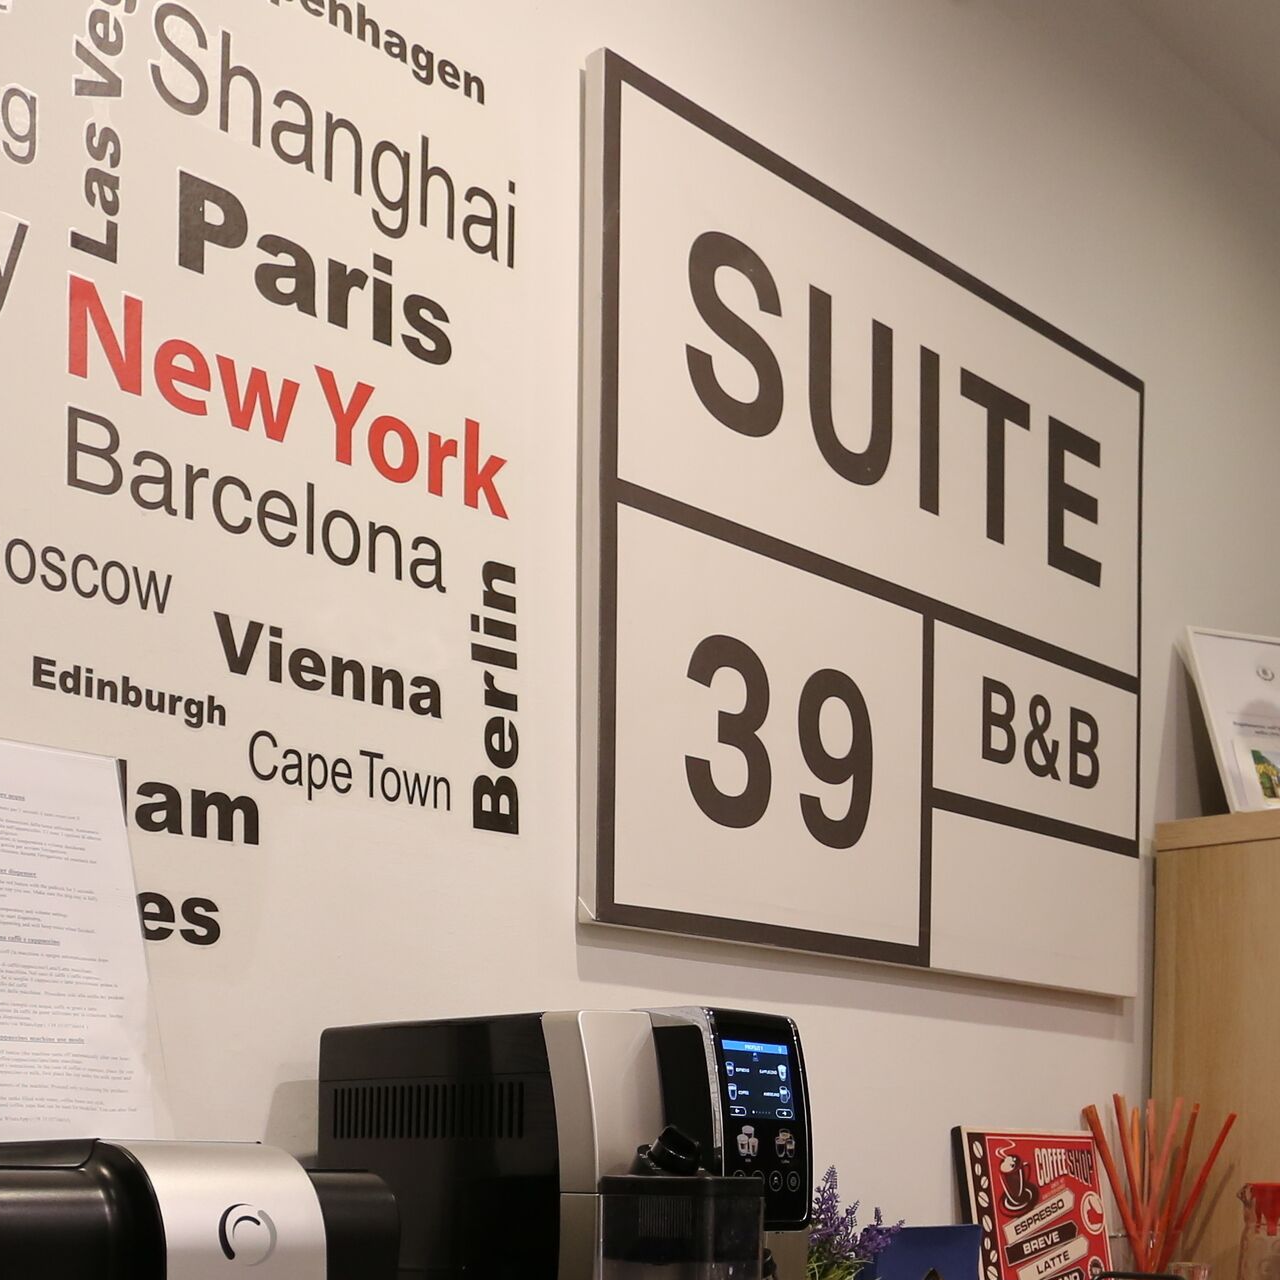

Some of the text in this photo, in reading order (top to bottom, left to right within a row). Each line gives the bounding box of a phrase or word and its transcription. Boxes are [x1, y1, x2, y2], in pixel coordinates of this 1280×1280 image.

[270, 0, 485, 106] enhagen
[70, 119, 122, 265] Las
[150, 2, 517, 270] Shanghai
[177, 169, 453, 366] Paris
[67, 274, 510, 520] New York
[684, 231, 1103, 588] SUITE
[66, 405, 447, 593] Barcelona
[32, 656, 227, 729] Edinburgh
[212, 611, 442, 719] Vienna
[470, 560, 520, 836] Berlin
[248, 730, 452, 812] Cape Town
[684, 634, 874, 850] 39
[981, 676, 1101, 790] B&B
[1014, 1198, 1066, 1236] ESPRESSO
[1034, 1147, 1094, 1188] COFFEE SHOP
[1022, 1230, 1061, 1255] BREVE
[1036, 1250, 1071, 1275] LATTE
